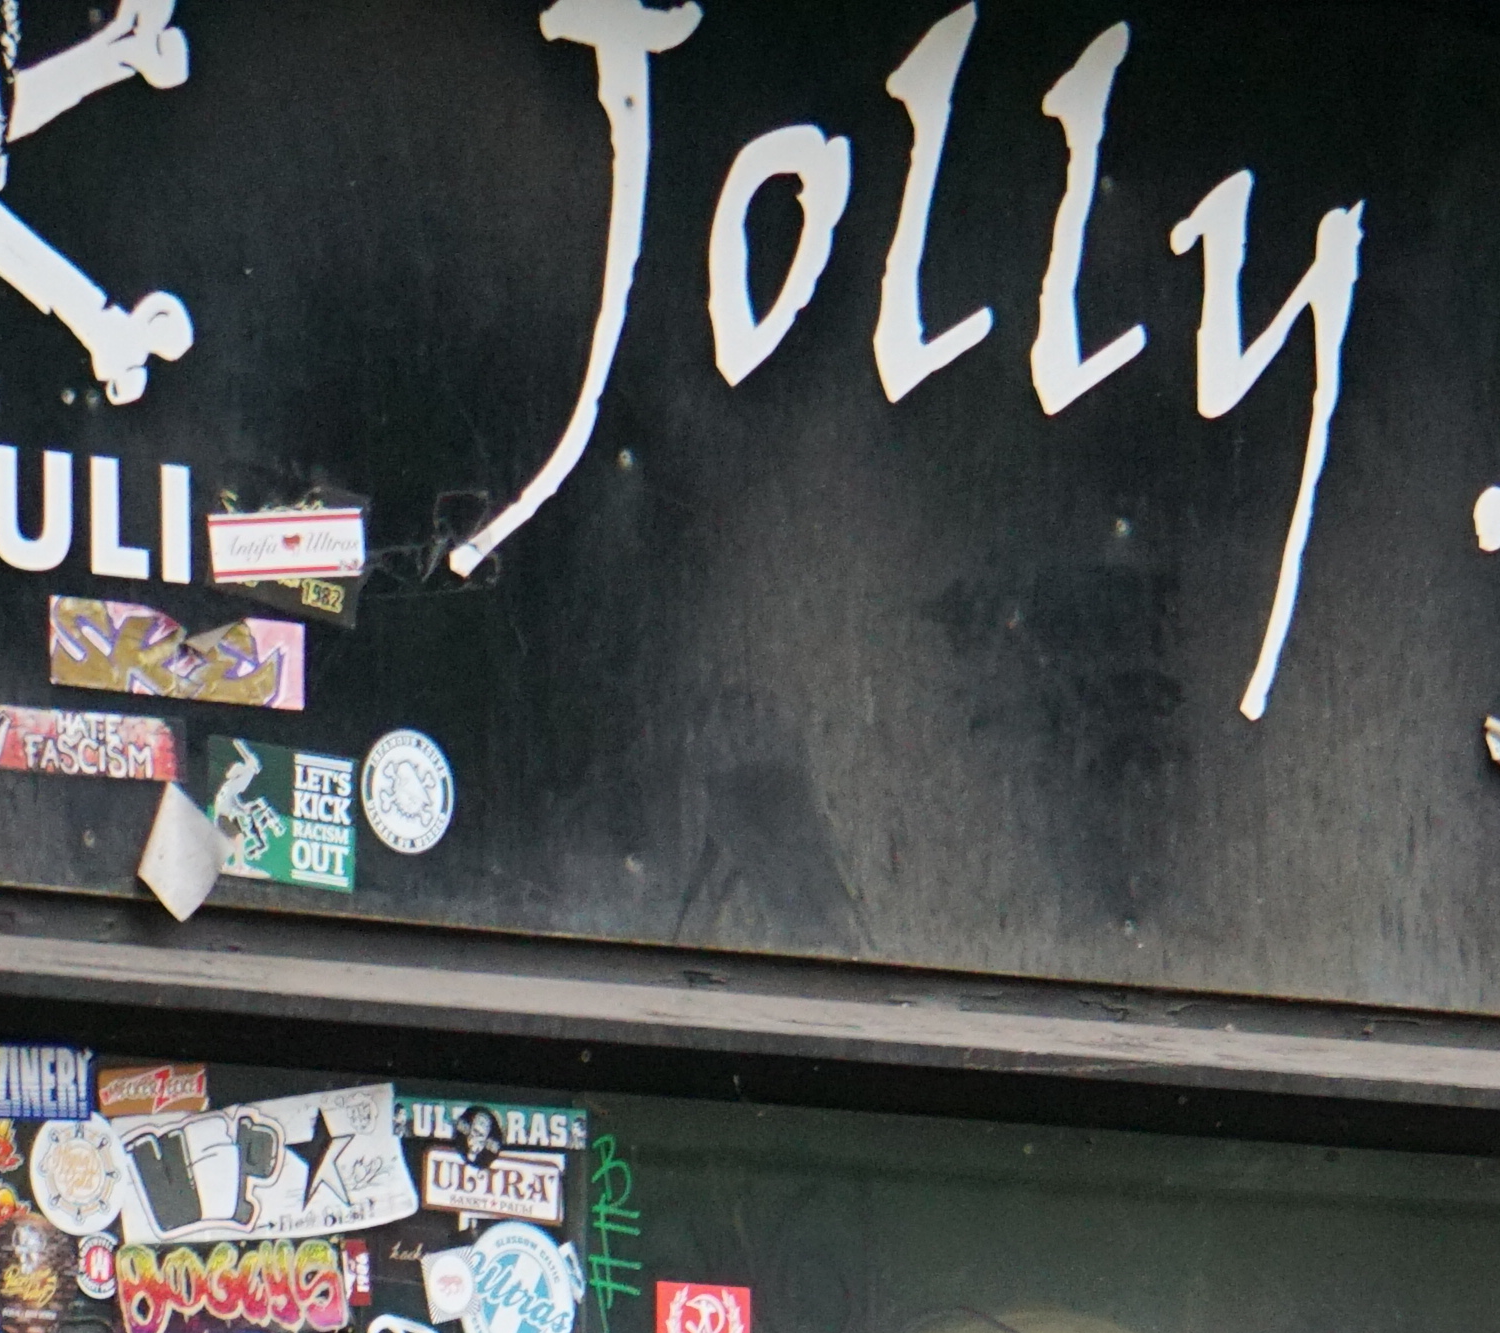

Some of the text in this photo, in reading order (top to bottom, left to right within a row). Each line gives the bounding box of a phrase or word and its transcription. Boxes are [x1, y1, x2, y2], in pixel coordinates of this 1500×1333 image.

[450, 0, 1366, 721] Jolly
[303, 580, 344, 611] 1982
[56, 712, 124, 743] HATE
[294, 766, 352, 797] LET'S
[293, 795, 351, 826] KICK
[292, 823, 349, 846] RACISM
[291, 842, 347, 875] OUT
